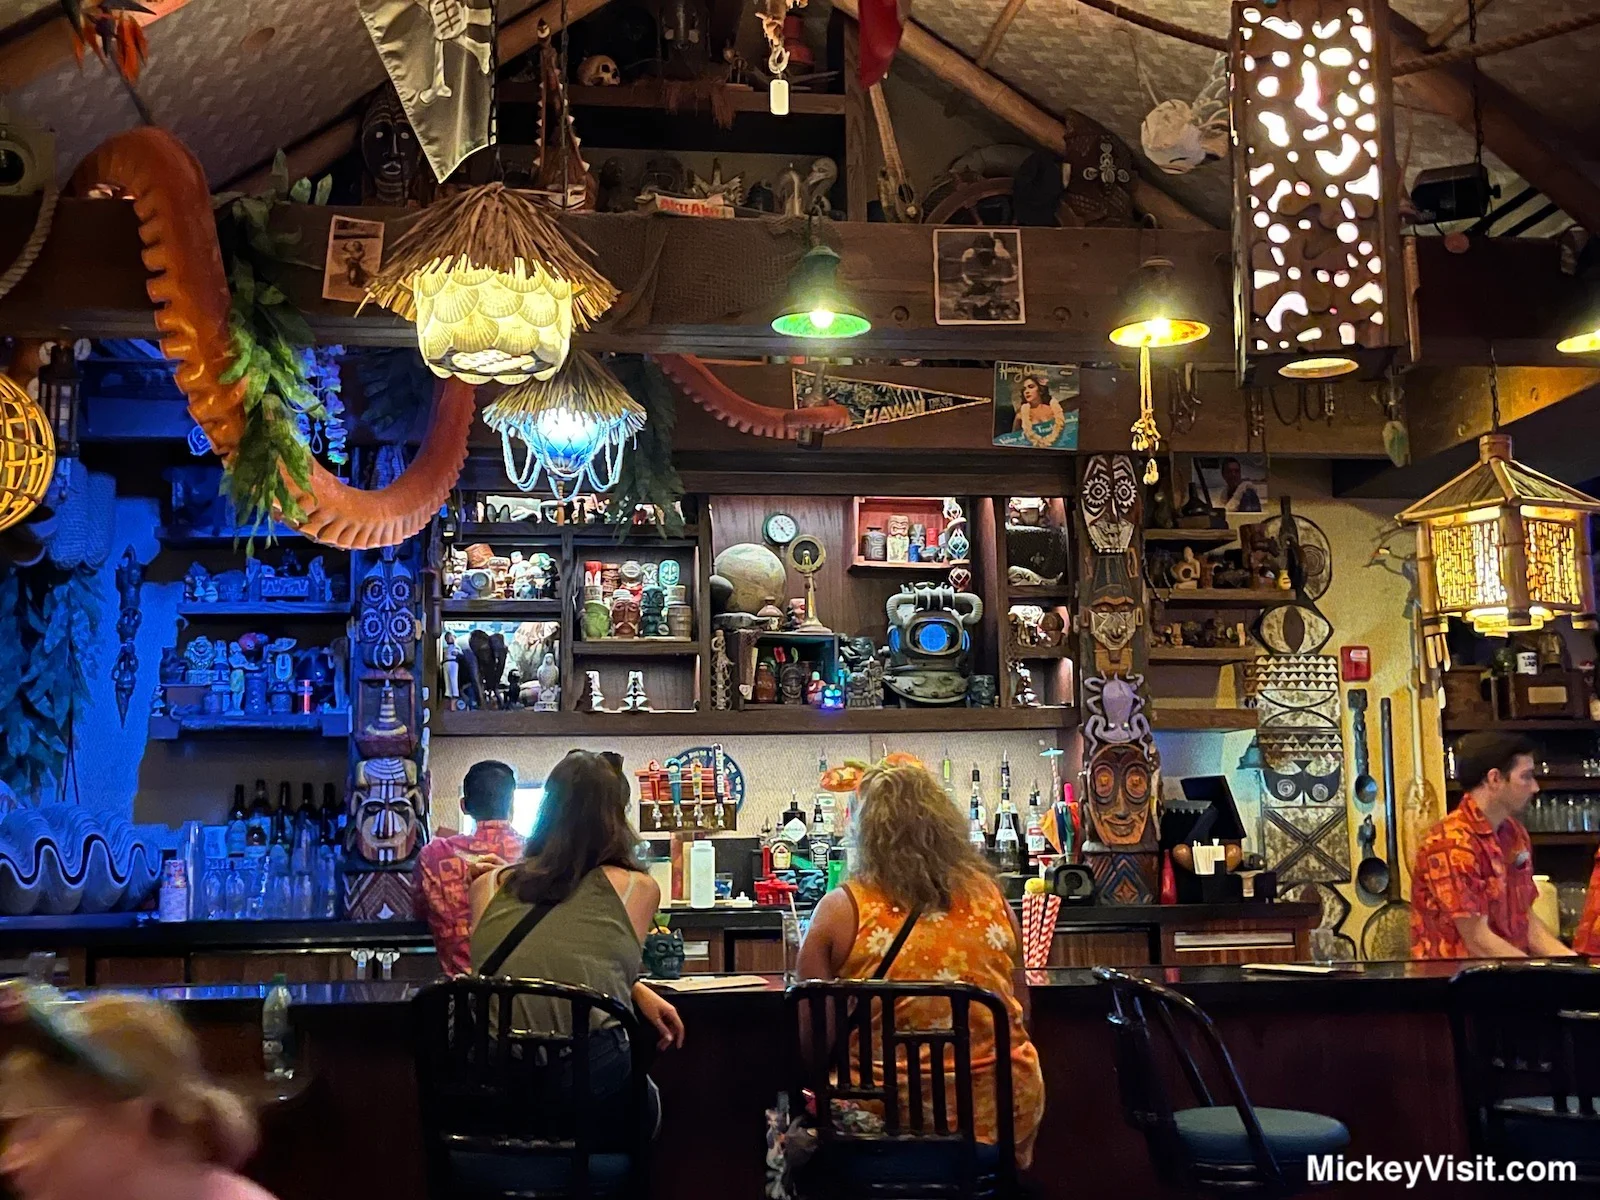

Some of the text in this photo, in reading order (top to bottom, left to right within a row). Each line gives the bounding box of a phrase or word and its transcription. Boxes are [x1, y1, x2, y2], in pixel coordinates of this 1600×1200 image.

[999, 362, 1023, 382] Harry
[863, 399, 926, 424] HAWAII
[715, 749, 724, 793] BUD LIGHT
